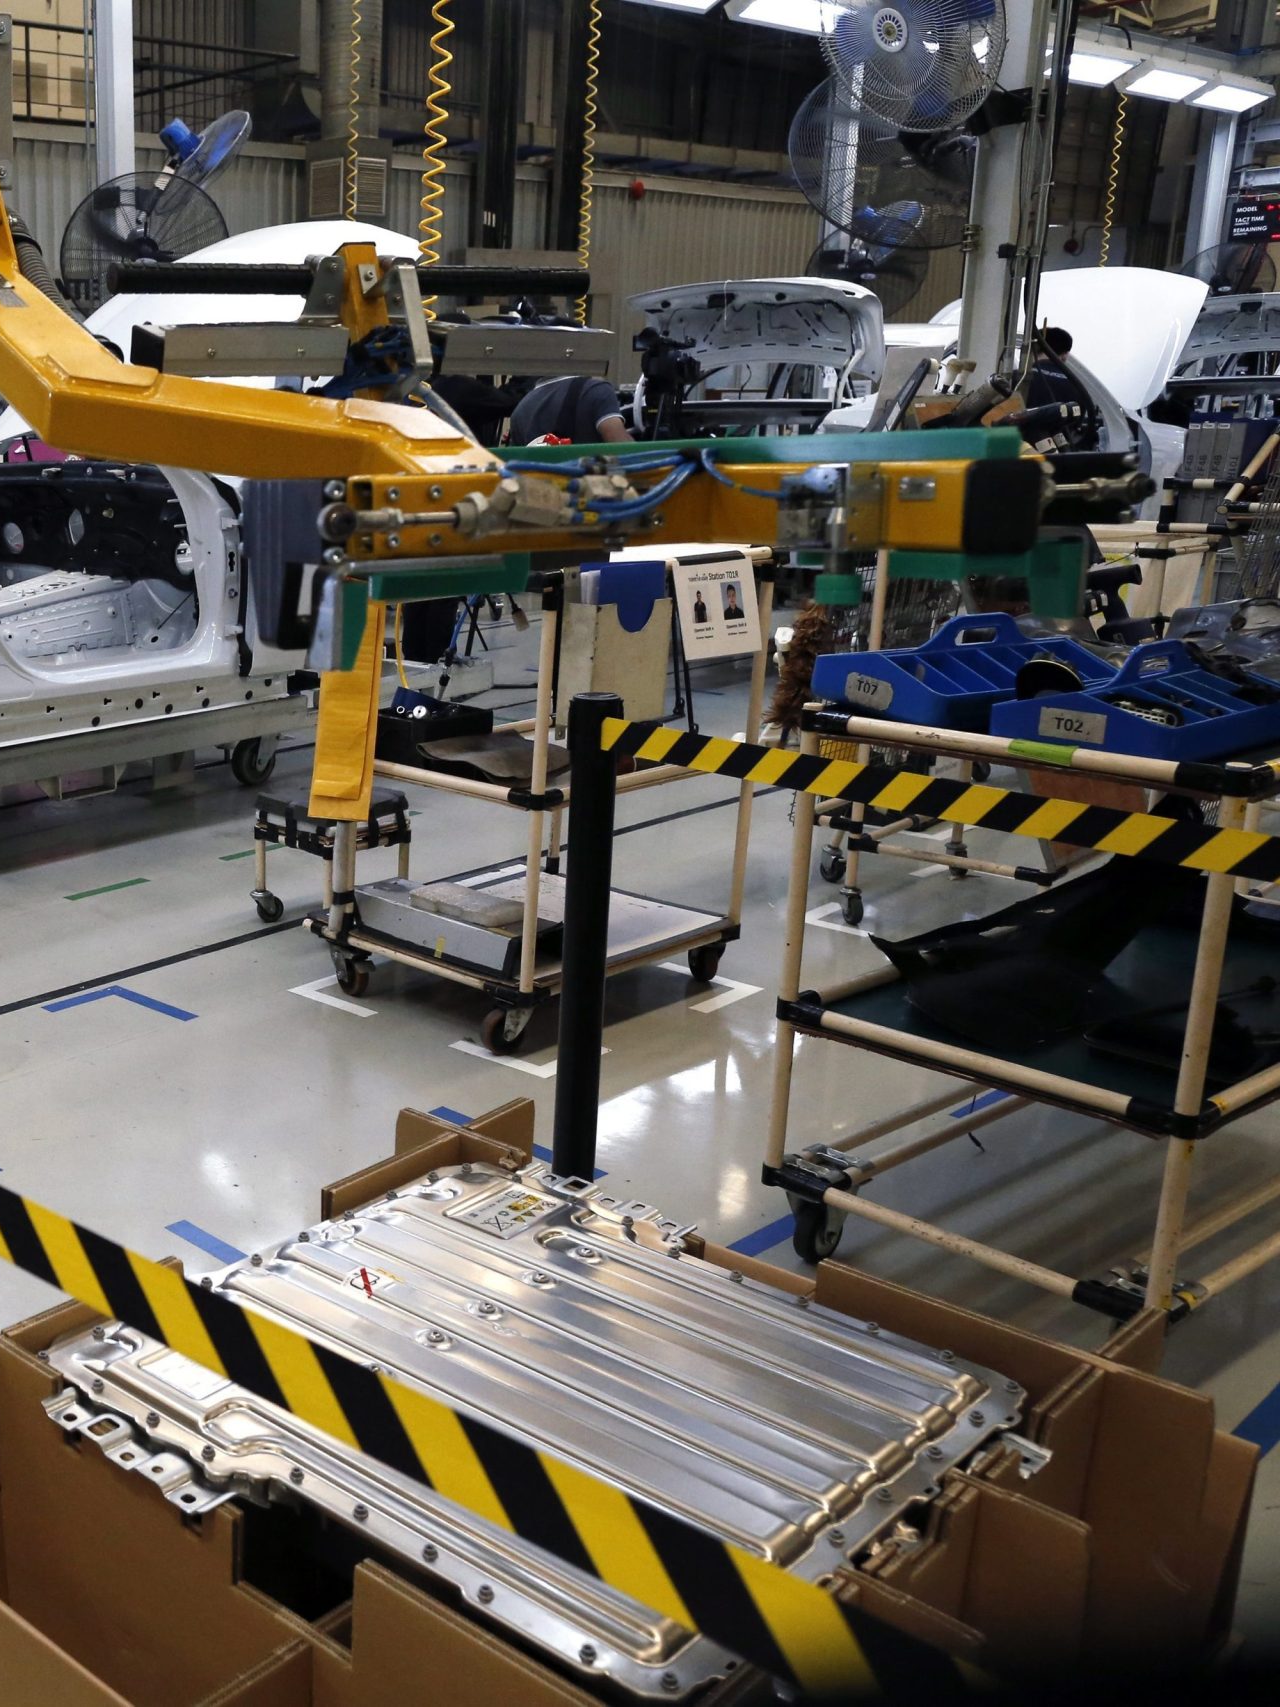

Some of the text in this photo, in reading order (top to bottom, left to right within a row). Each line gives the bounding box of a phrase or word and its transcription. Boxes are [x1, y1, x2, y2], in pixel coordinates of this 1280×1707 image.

[1233, 225, 1268, 233] REMAINING
[708, 571, 726, 581] Station
[857, 679, 879, 696] T07
[1055, 716, 1084, 733] T02
